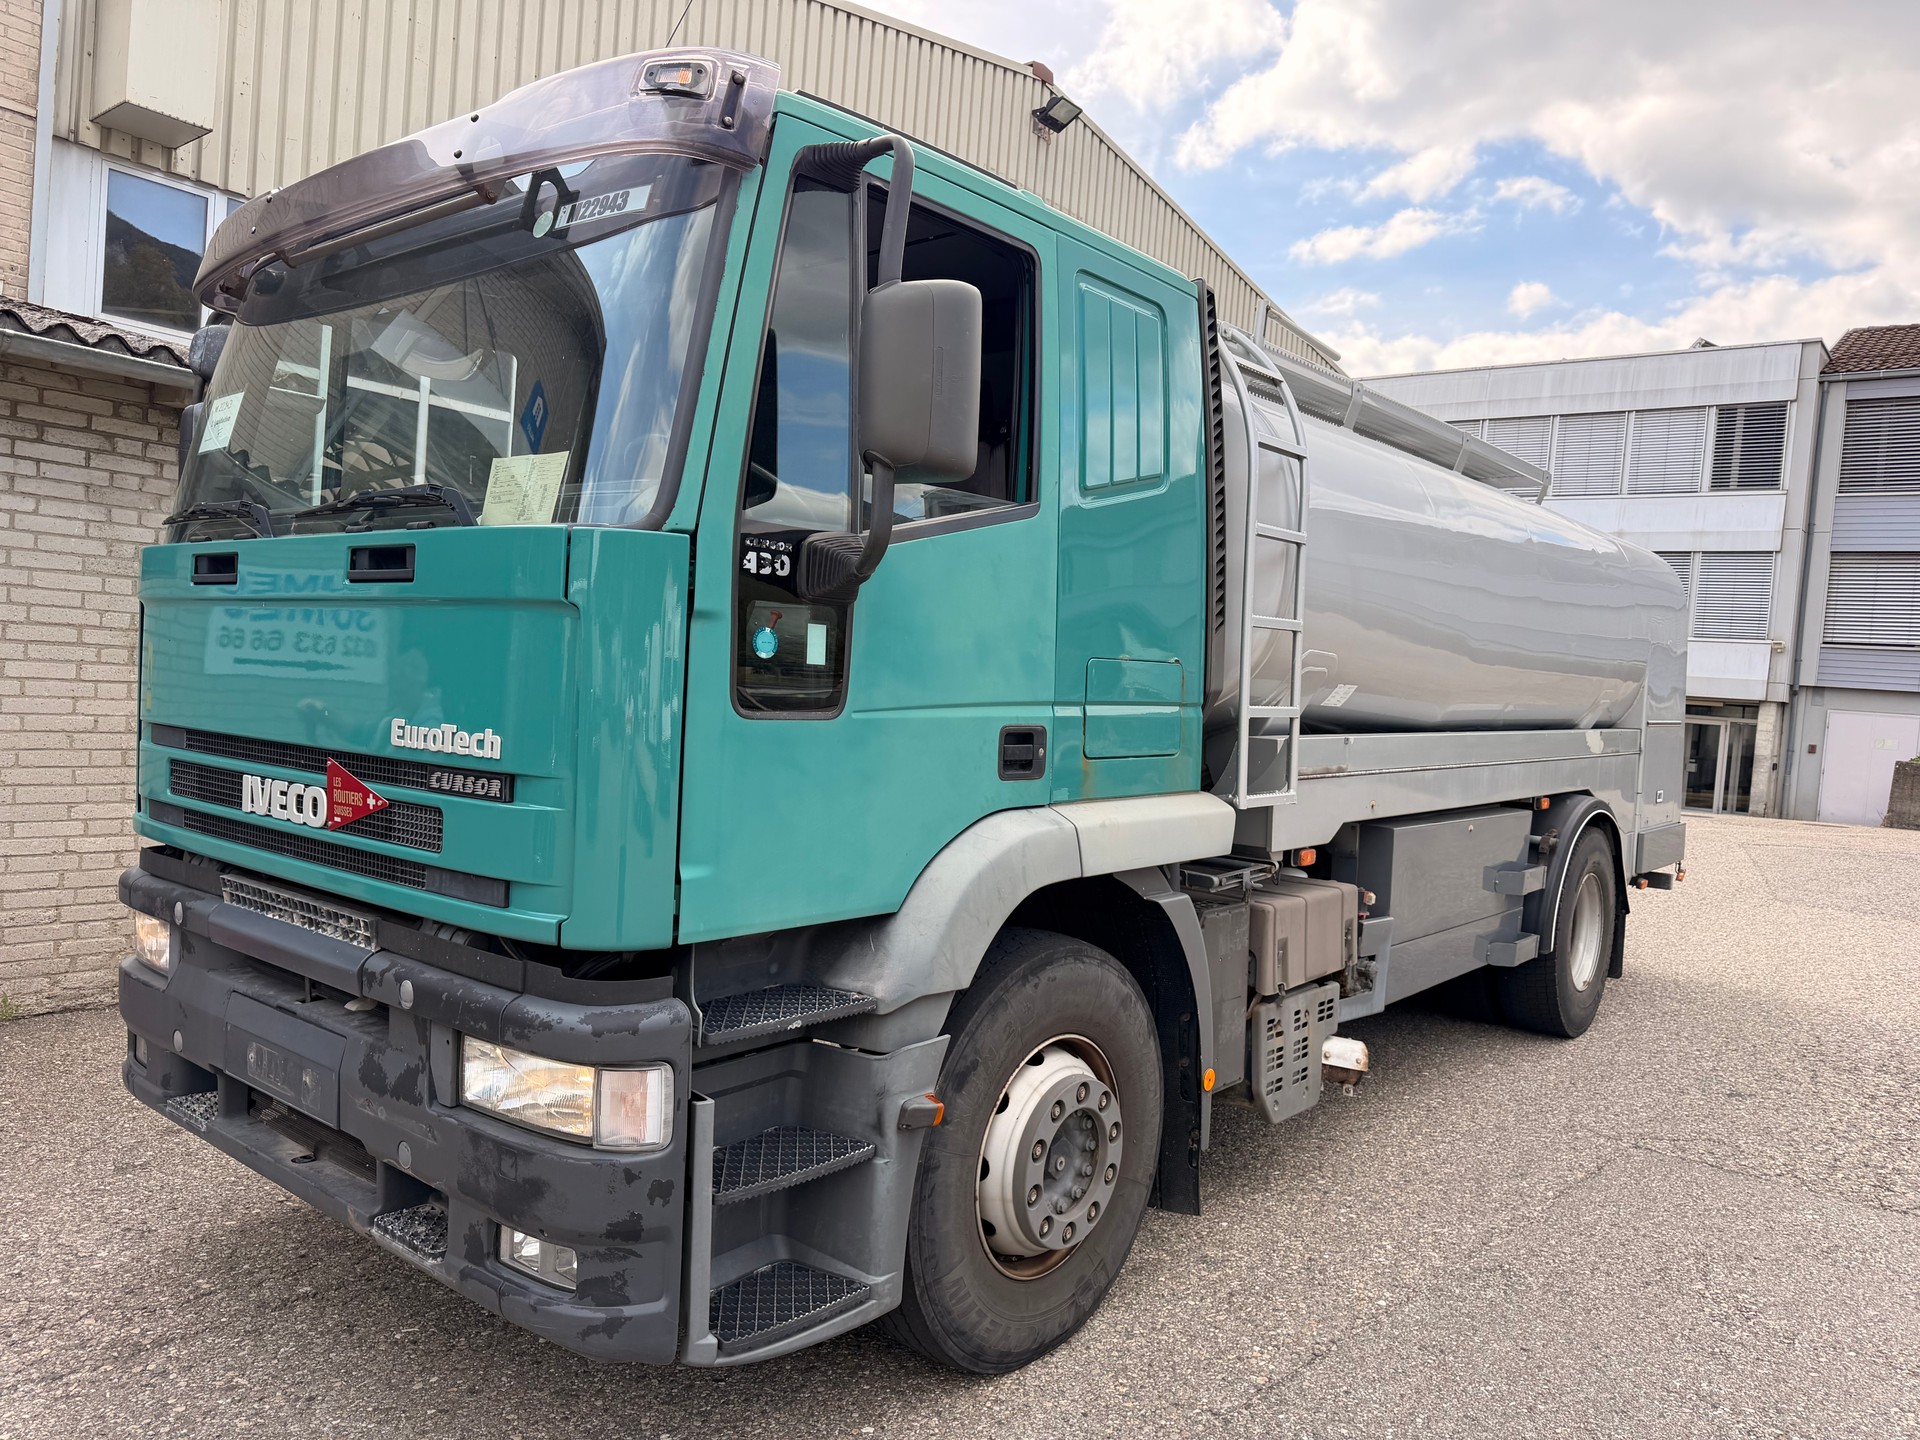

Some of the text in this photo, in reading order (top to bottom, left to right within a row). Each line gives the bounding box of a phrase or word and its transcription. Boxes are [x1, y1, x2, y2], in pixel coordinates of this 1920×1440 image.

[390, 717, 502, 760] EuroTech
[333, 776, 342, 788] LES
[428, 770, 503, 798] CURSOR
[241, 774, 328, 828] IVECO
[333, 788, 363, 806] ROUTIERS
[333, 804, 353, 818] SUISSES
